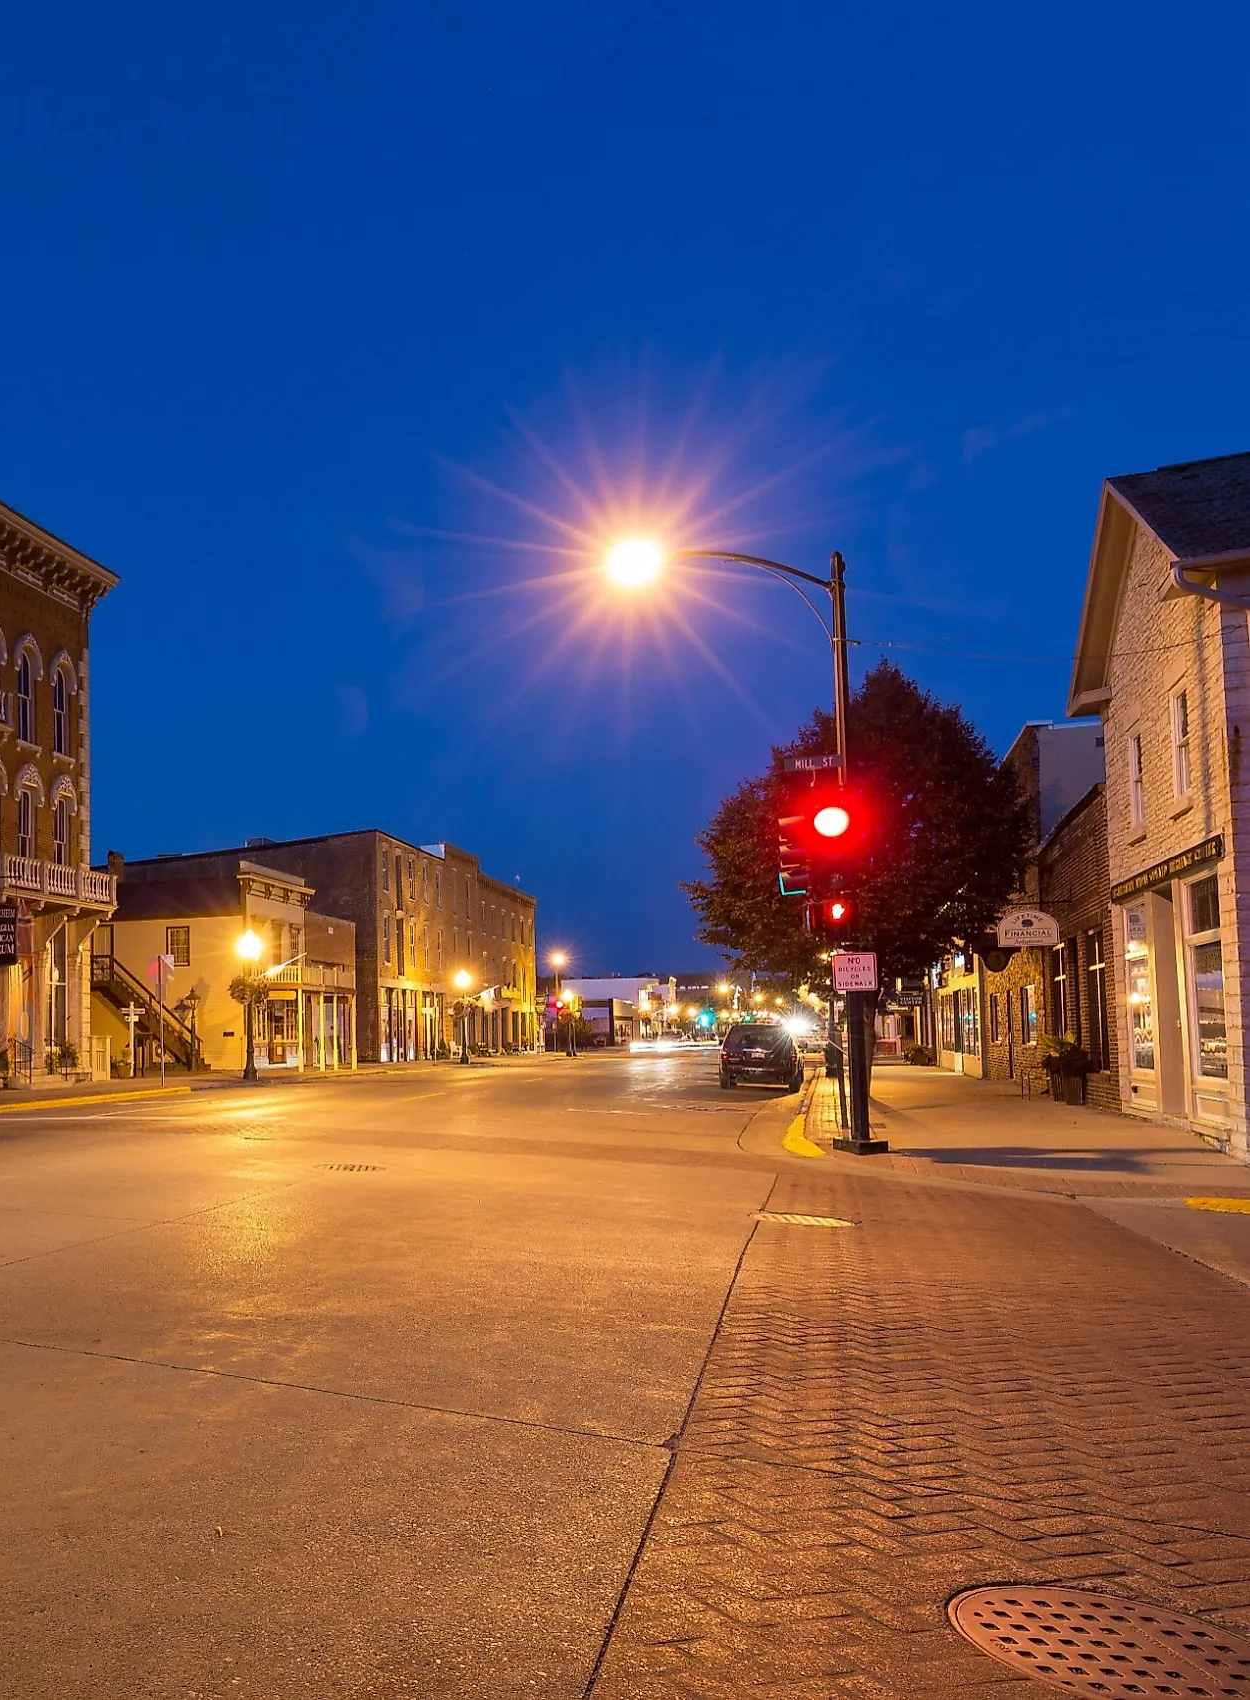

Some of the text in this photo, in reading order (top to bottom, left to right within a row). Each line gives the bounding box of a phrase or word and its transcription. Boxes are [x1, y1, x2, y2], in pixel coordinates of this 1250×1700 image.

[795, 756, 833, 769] MILL ST
[1011, 914, 1043, 924] LIFETIME
